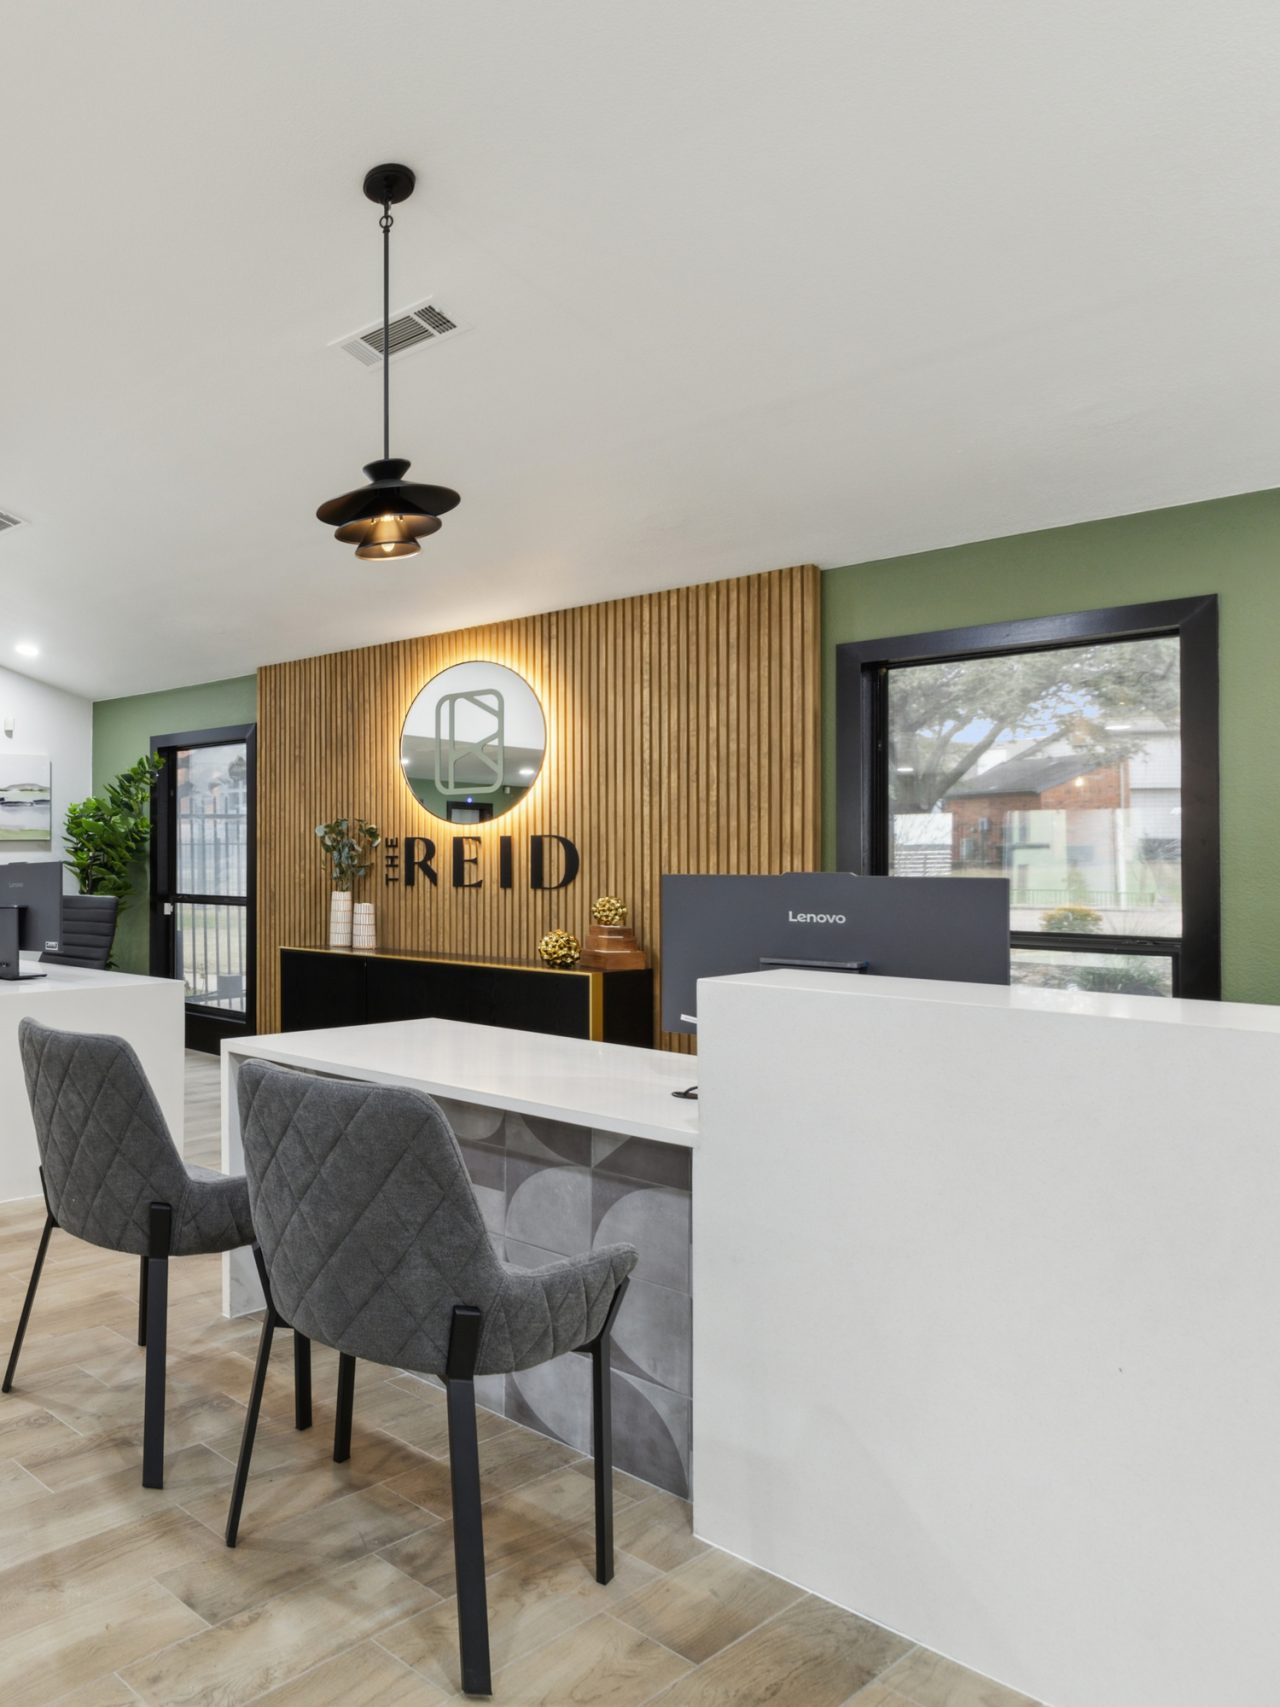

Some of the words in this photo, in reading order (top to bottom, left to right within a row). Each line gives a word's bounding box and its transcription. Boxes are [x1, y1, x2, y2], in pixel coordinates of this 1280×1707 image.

[385, 836, 399, 886] THE
[404, 834, 580, 890] REID
[788, 910, 847, 924] Lenovo
